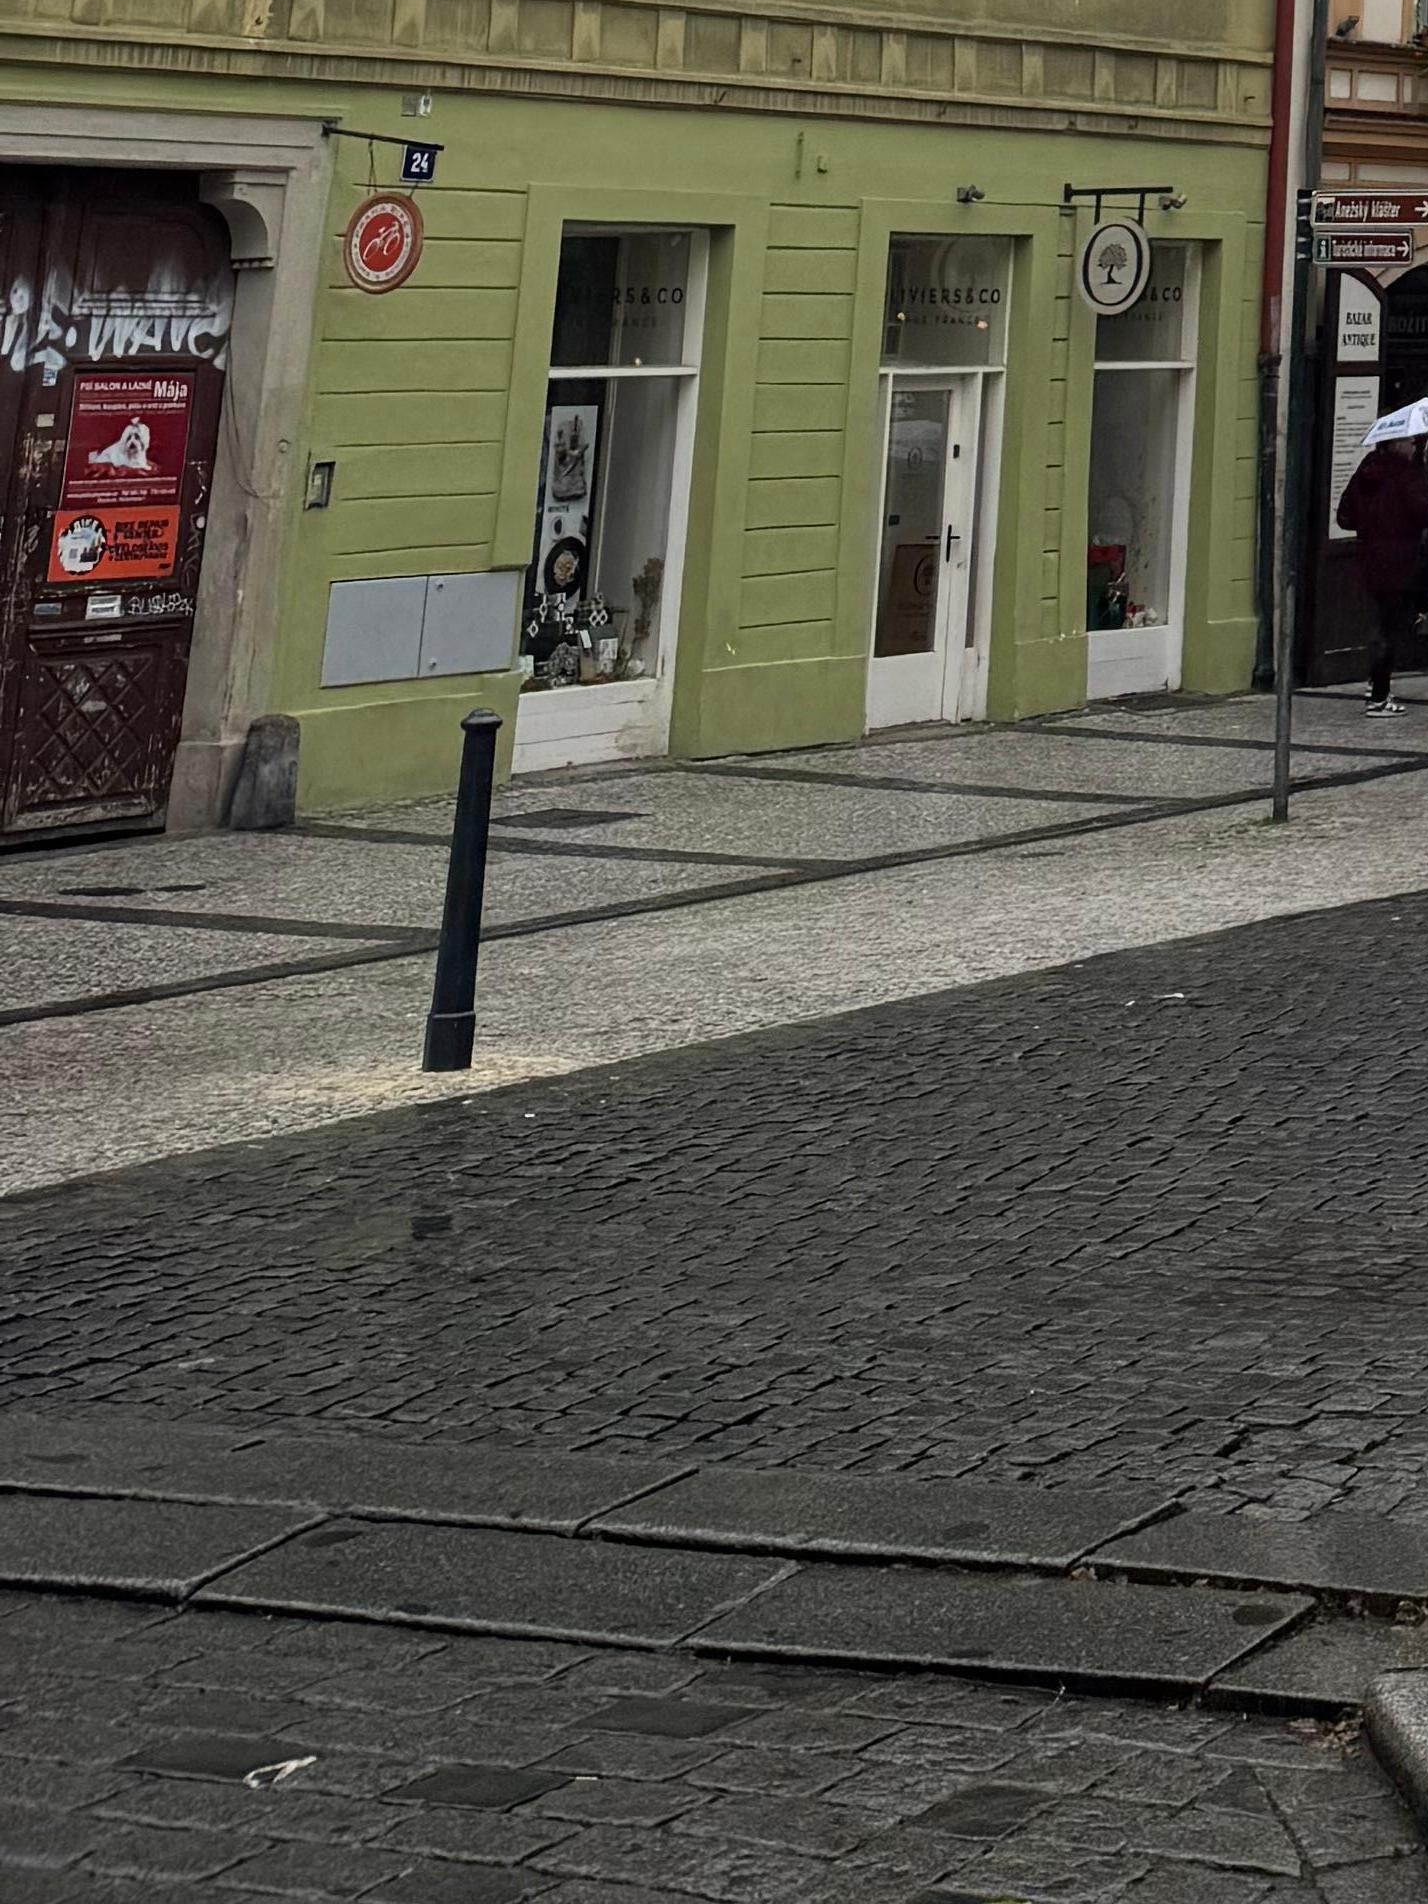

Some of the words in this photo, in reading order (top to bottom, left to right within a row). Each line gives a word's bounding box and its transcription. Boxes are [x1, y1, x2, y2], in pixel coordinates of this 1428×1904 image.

[410, 152, 429, 172] 24
[1335, 200, 1369, 222] Anežský
[1346, 312, 1373, 326] BAZAR
[1343, 334, 1376, 347] ANTIQUE
[154, 380, 188, 401] Mája
